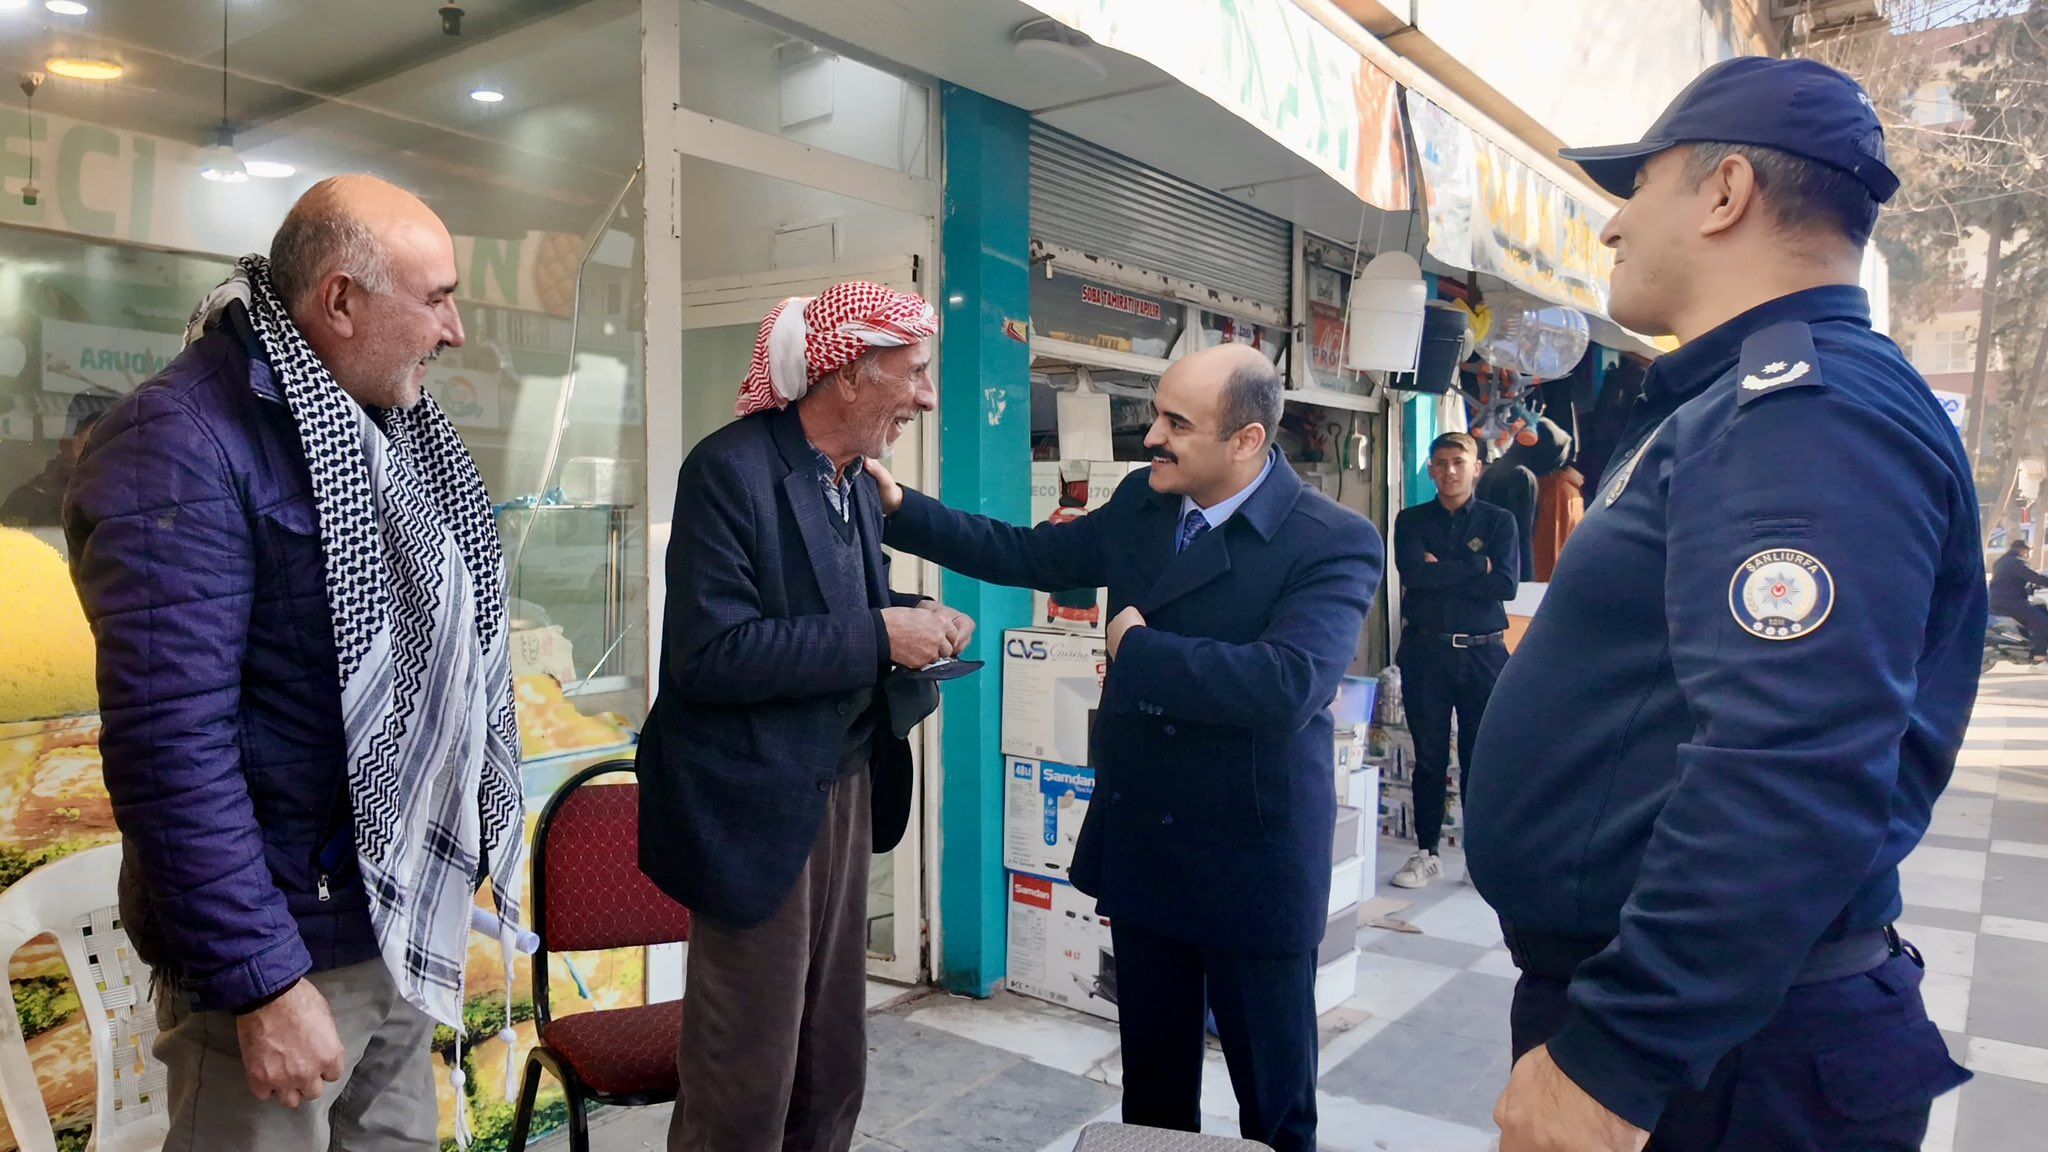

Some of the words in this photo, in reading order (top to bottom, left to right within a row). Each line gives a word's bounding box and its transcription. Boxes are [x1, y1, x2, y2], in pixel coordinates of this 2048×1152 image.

[1082, 285, 1102, 305] SOBA
[1031, 486, 1057, 497] ECO
[1007, 638, 1048, 660] CVS
